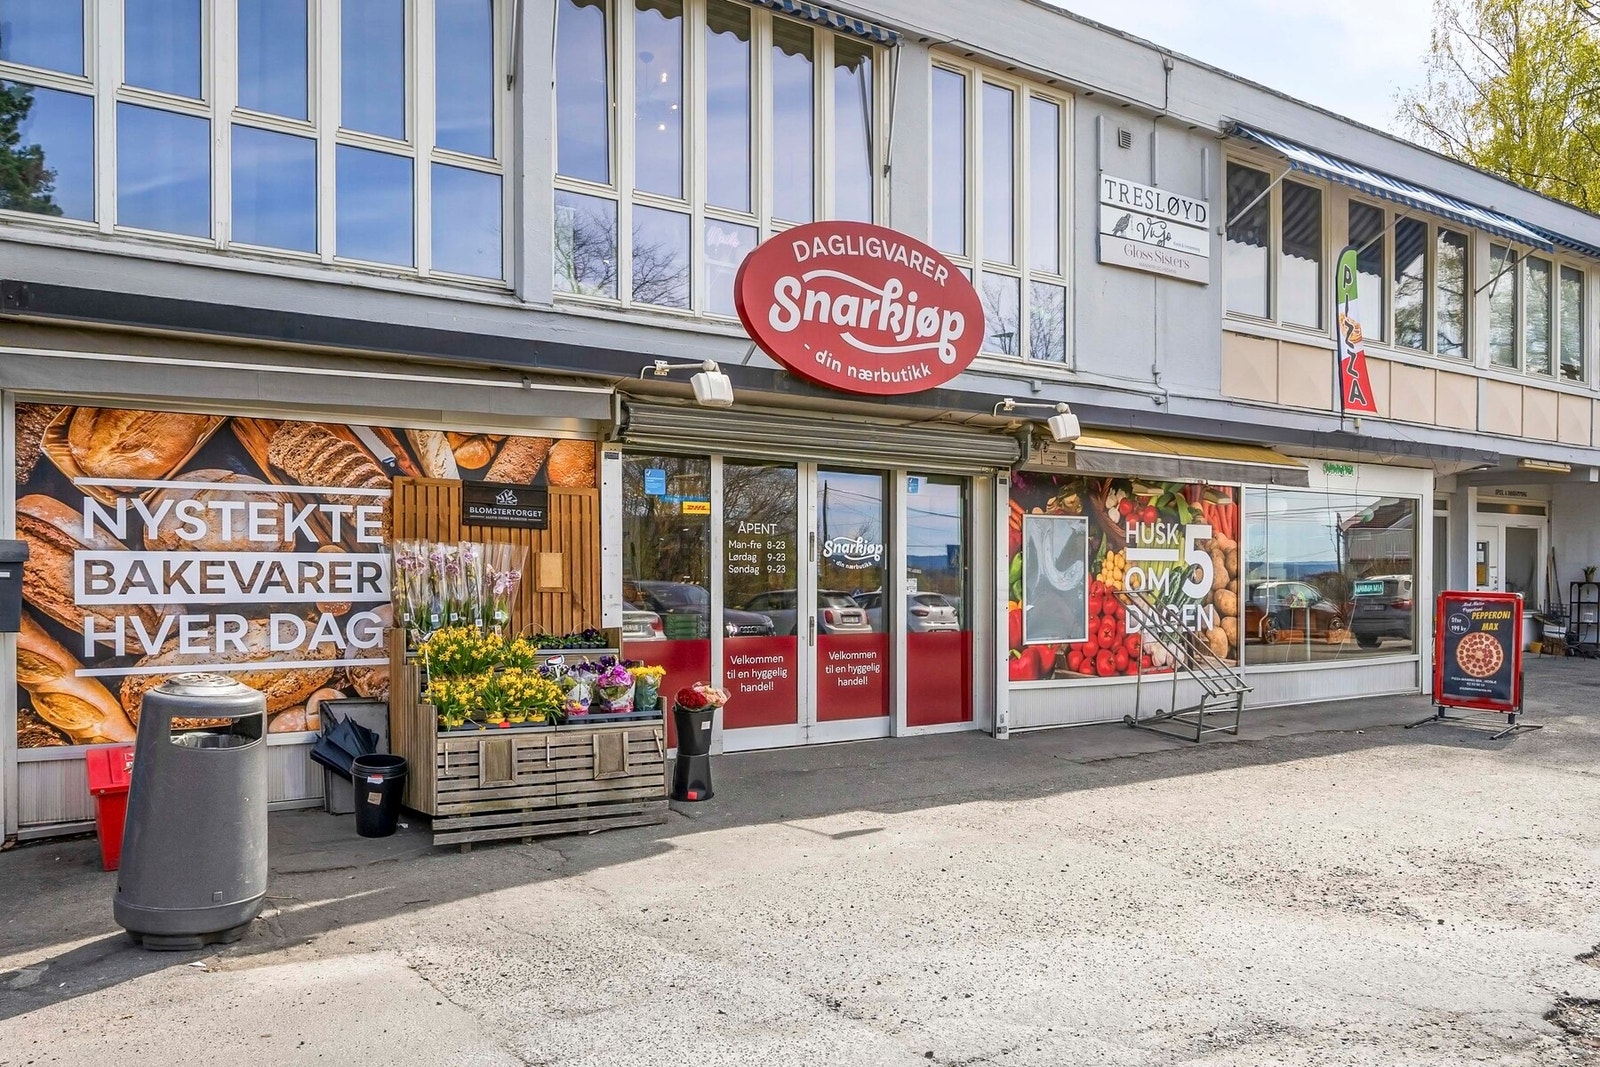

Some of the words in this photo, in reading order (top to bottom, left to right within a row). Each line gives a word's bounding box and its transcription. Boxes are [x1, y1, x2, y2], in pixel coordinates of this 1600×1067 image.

[1104, 179, 1206, 223] TRESLØYD
[792, 234, 949, 287] DAGLIGVARER
[1123, 243, 1153, 262] Gloss
[1154, 249, 1190, 269] Sisters
[768, 269, 965, 365] Snarkjøp
[1342, 264, 1367, 406] PIZZA
[815, 350, 842, 373] din
[847, 362, 932, 383] nærbutikk
[469, 506, 542, 517] BLOMSTERTORGET
[83, 496, 384, 543] NYSTEKTE
[737, 520, 778, 535] ÅPENT
[728, 539, 762, 549] Man-fre
[766, 540, 786, 550] 8-23
[823, 536, 884, 561] Snarkjøp
[728, 552, 757, 564] Lørdag
[767, 552, 786, 562] 9-23
[845, 561, 873, 570] nærbutikk
[1125, 521, 1179, 545] HUSK
[1182, 524, 1214, 599] 5
[84, 559, 384, 596] BAKEVARER
[728, 564, 760, 576] Søndag
[766, 564, 786, 574] 9-23
[1125, 566, 1170, 597] OM
[1125, 603, 1214, 634] DAGEN
[1471, 610, 1511, 620] PEPPERONI
[1481, 622, 1499, 631] MAX
[84, 613, 249, 658] HVER
[269, 611, 384, 653] DAG
[730, 654, 784, 665] Velkommen
[828, 650, 877, 661] Velkommen
[726, 669, 736, 679] til
[751, 667, 788, 680] hyggelig
[825, 664, 834, 674] til
[847, 662, 880, 675] hyggelig
[740, 682, 774, 692] handel!
[837, 676, 868, 687] handel!
